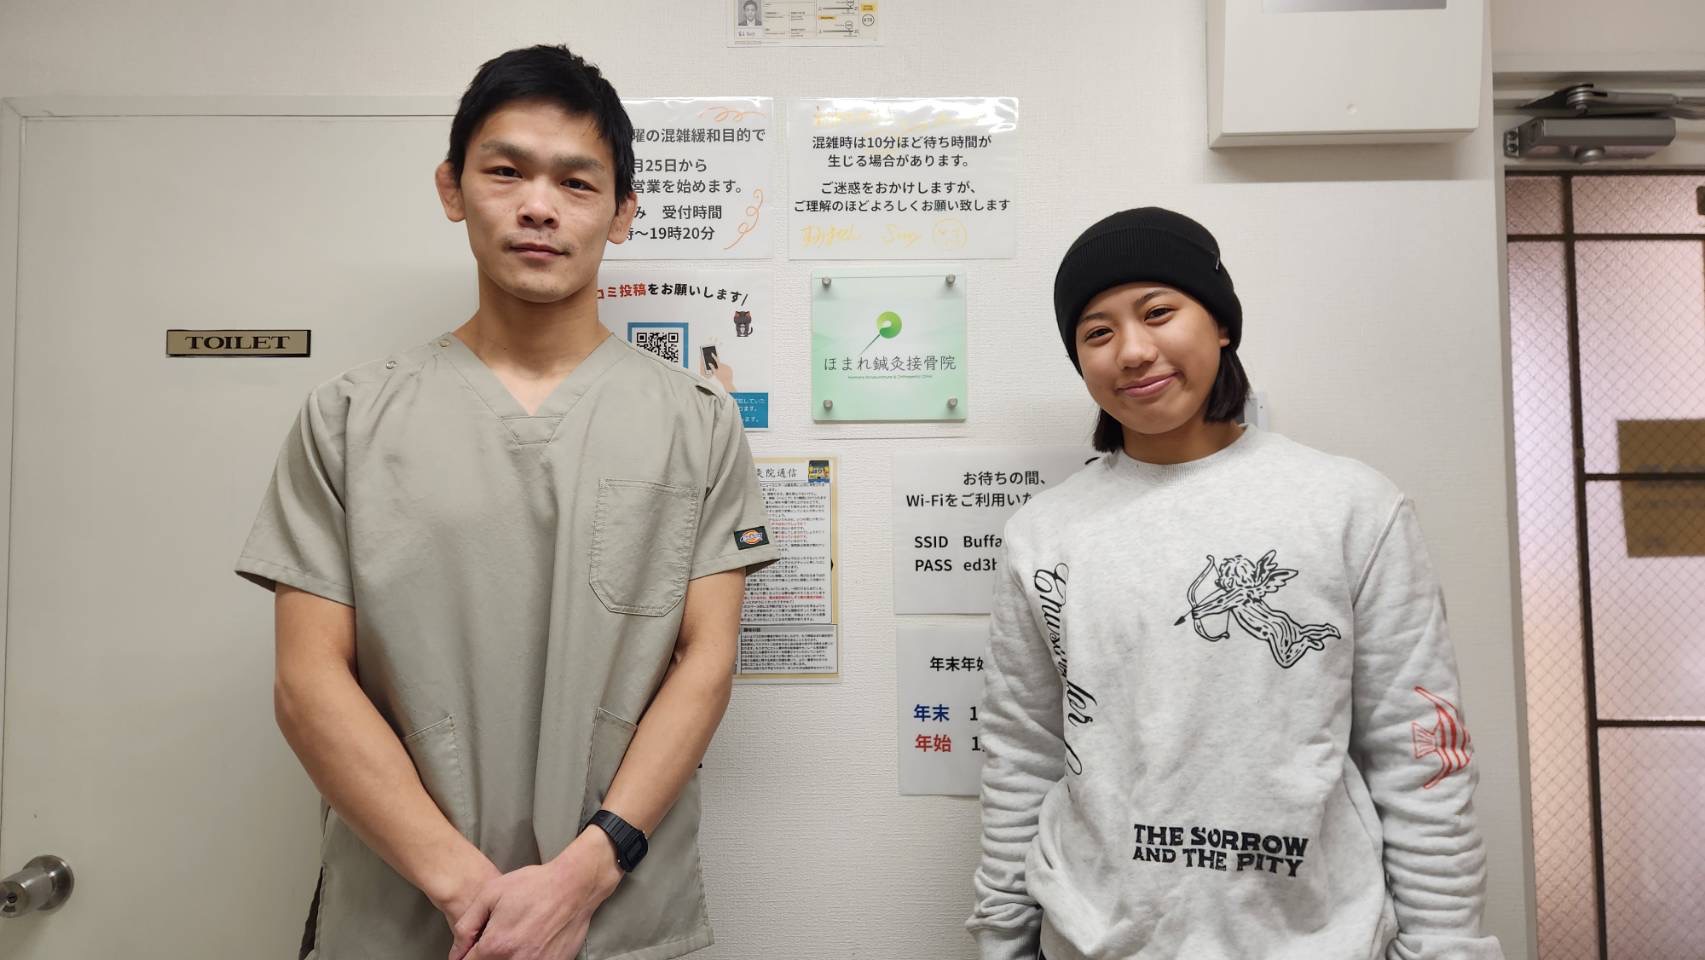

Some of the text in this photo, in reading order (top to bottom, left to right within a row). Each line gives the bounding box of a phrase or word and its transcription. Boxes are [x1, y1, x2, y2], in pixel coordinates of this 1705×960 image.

[812, 135, 992, 149] 混雑時は10分ほど待ち時間が
[827, 154, 969, 168] 生じる場合があります。
[631, 179, 742, 194] 営業を始めます。
[821, 181, 976, 195] ご迷惑をおかけしますが、
[662, 205, 722, 220] 受付時間
[794, 199, 1011, 213] ご理解のほどよろしくお願い致します
[184, 336, 290, 350] TOILET
[824, 355, 957, 371] ほまれ鍼灸接骨院
[963, 470, 1046, 486] お待ちの間、
[914, 535, 949, 549] SSID
[915, 558, 953, 572] PASS
[913, 703, 950, 722] 年末
[915, 734, 952, 752] 年始
[1134, 823, 1309, 857] THE SORROW
[1132, 846, 1303, 877] AND THE PITY
